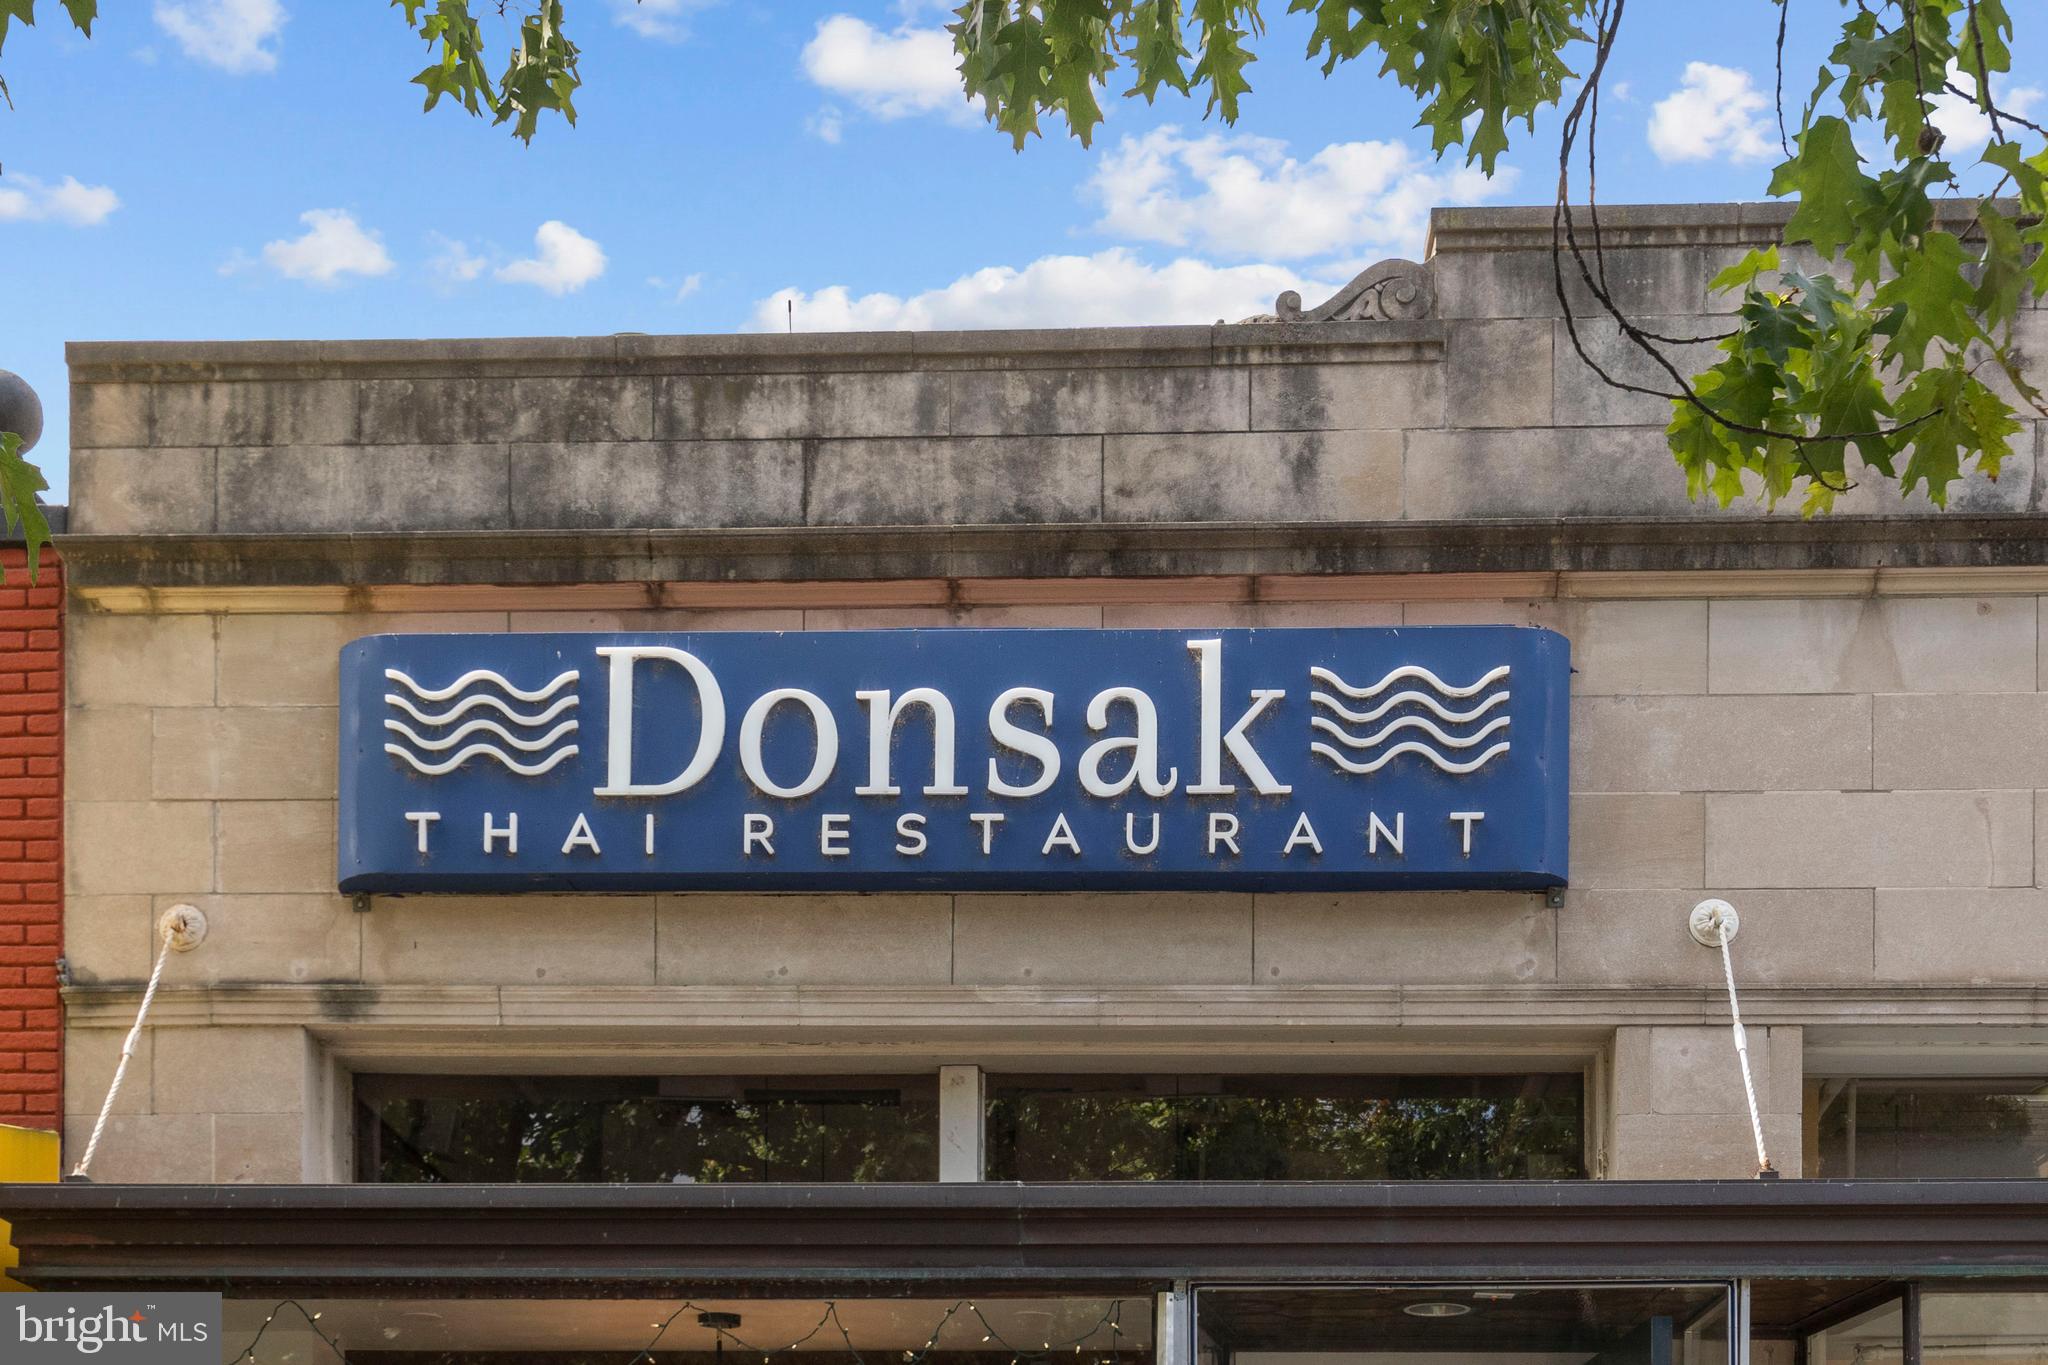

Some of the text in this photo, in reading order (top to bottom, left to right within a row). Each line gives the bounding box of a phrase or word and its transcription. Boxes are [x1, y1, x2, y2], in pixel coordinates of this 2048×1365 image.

[592, 638, 1293, 798] Donsak
[404, 811, 1485, 855] THAI RESTAURANT
